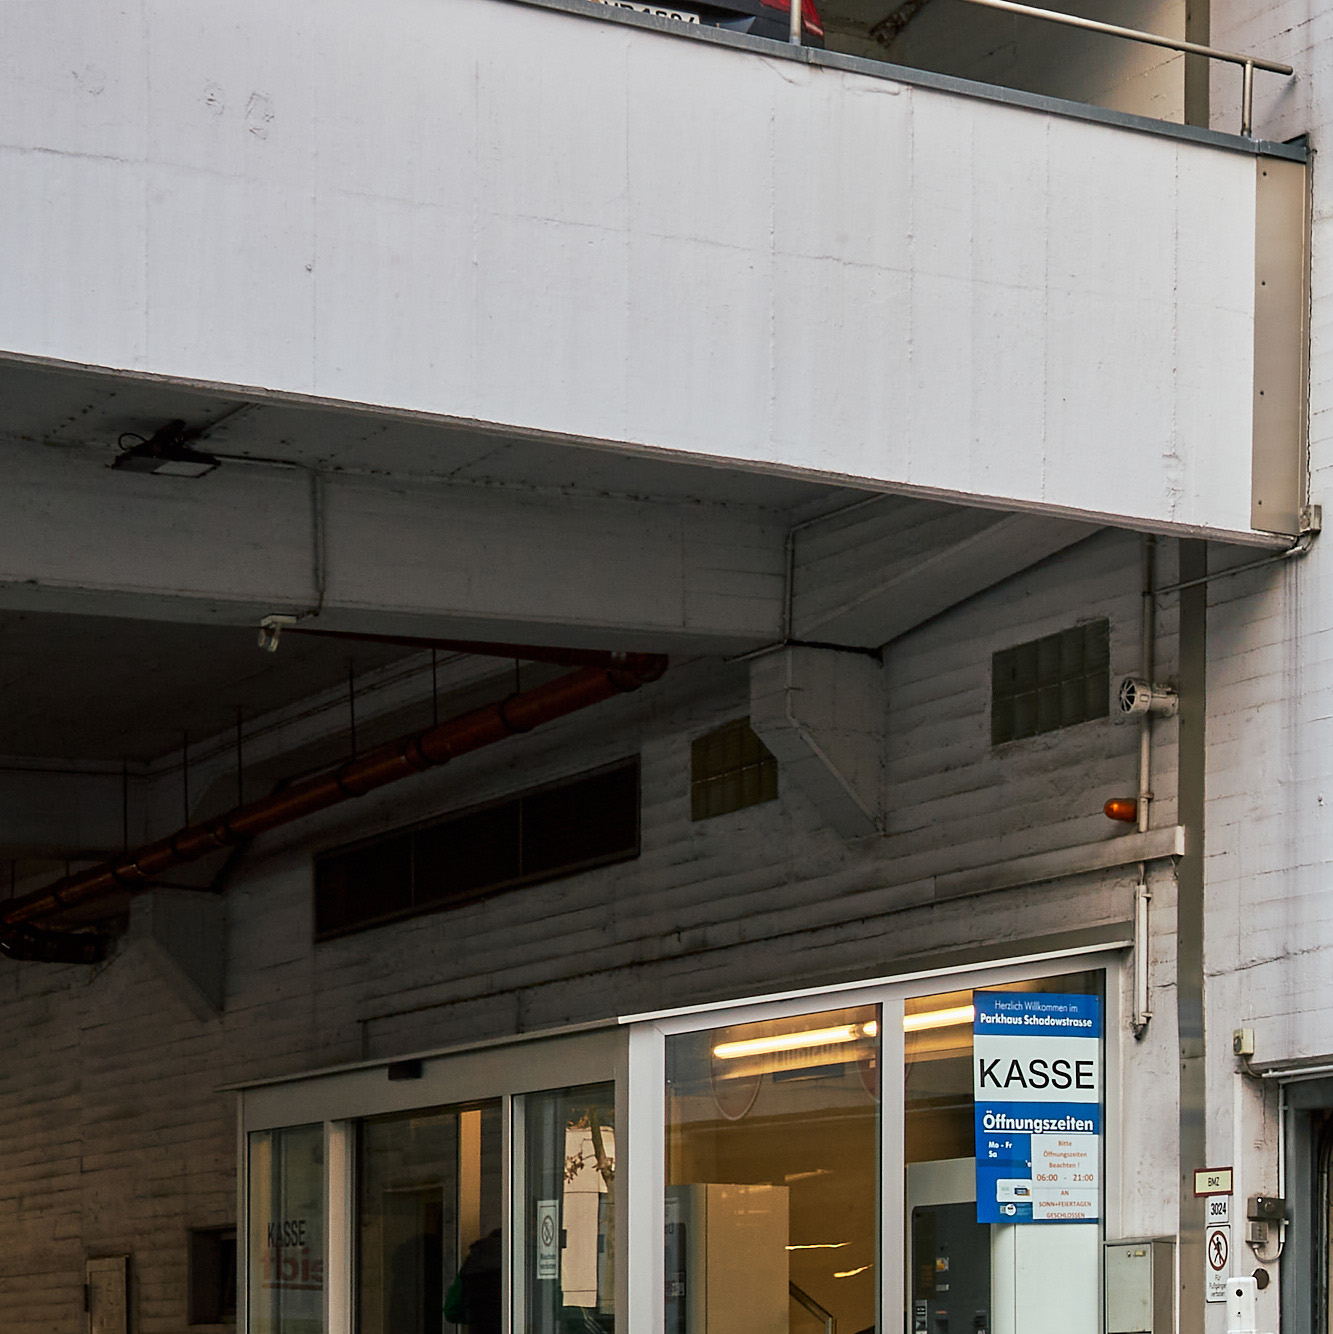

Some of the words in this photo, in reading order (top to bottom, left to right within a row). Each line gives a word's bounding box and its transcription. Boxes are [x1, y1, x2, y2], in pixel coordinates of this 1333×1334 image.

[994, 1000, 1023, 1010] Herzlich
[1025, 1002, 1067, 1012] Willkommen
[1069, 1004, 1078, 1012] im
[980, 1013, 1022, 1025] Parkhaus
[1024, 1015, 1093, 1027] Schadowstrasse
[979, 1058, 1094, 1089] KASSE
[983, 1110, 1094, 1134] Öffnungszeiten
[988, 1150, 998, 1158] Sa
[1043, 1150, 1087, 1158] Öffnungszeiten
[1036, 1173, 1058, 1182] 06:00
[1073, 1174, 1094, 1182] 21:00
[1207, 1176, 1220, 1187] BMZ
[1210, 1202, 1227, 1216] 3024
[267, 1219, 307, 1248] KASSE
